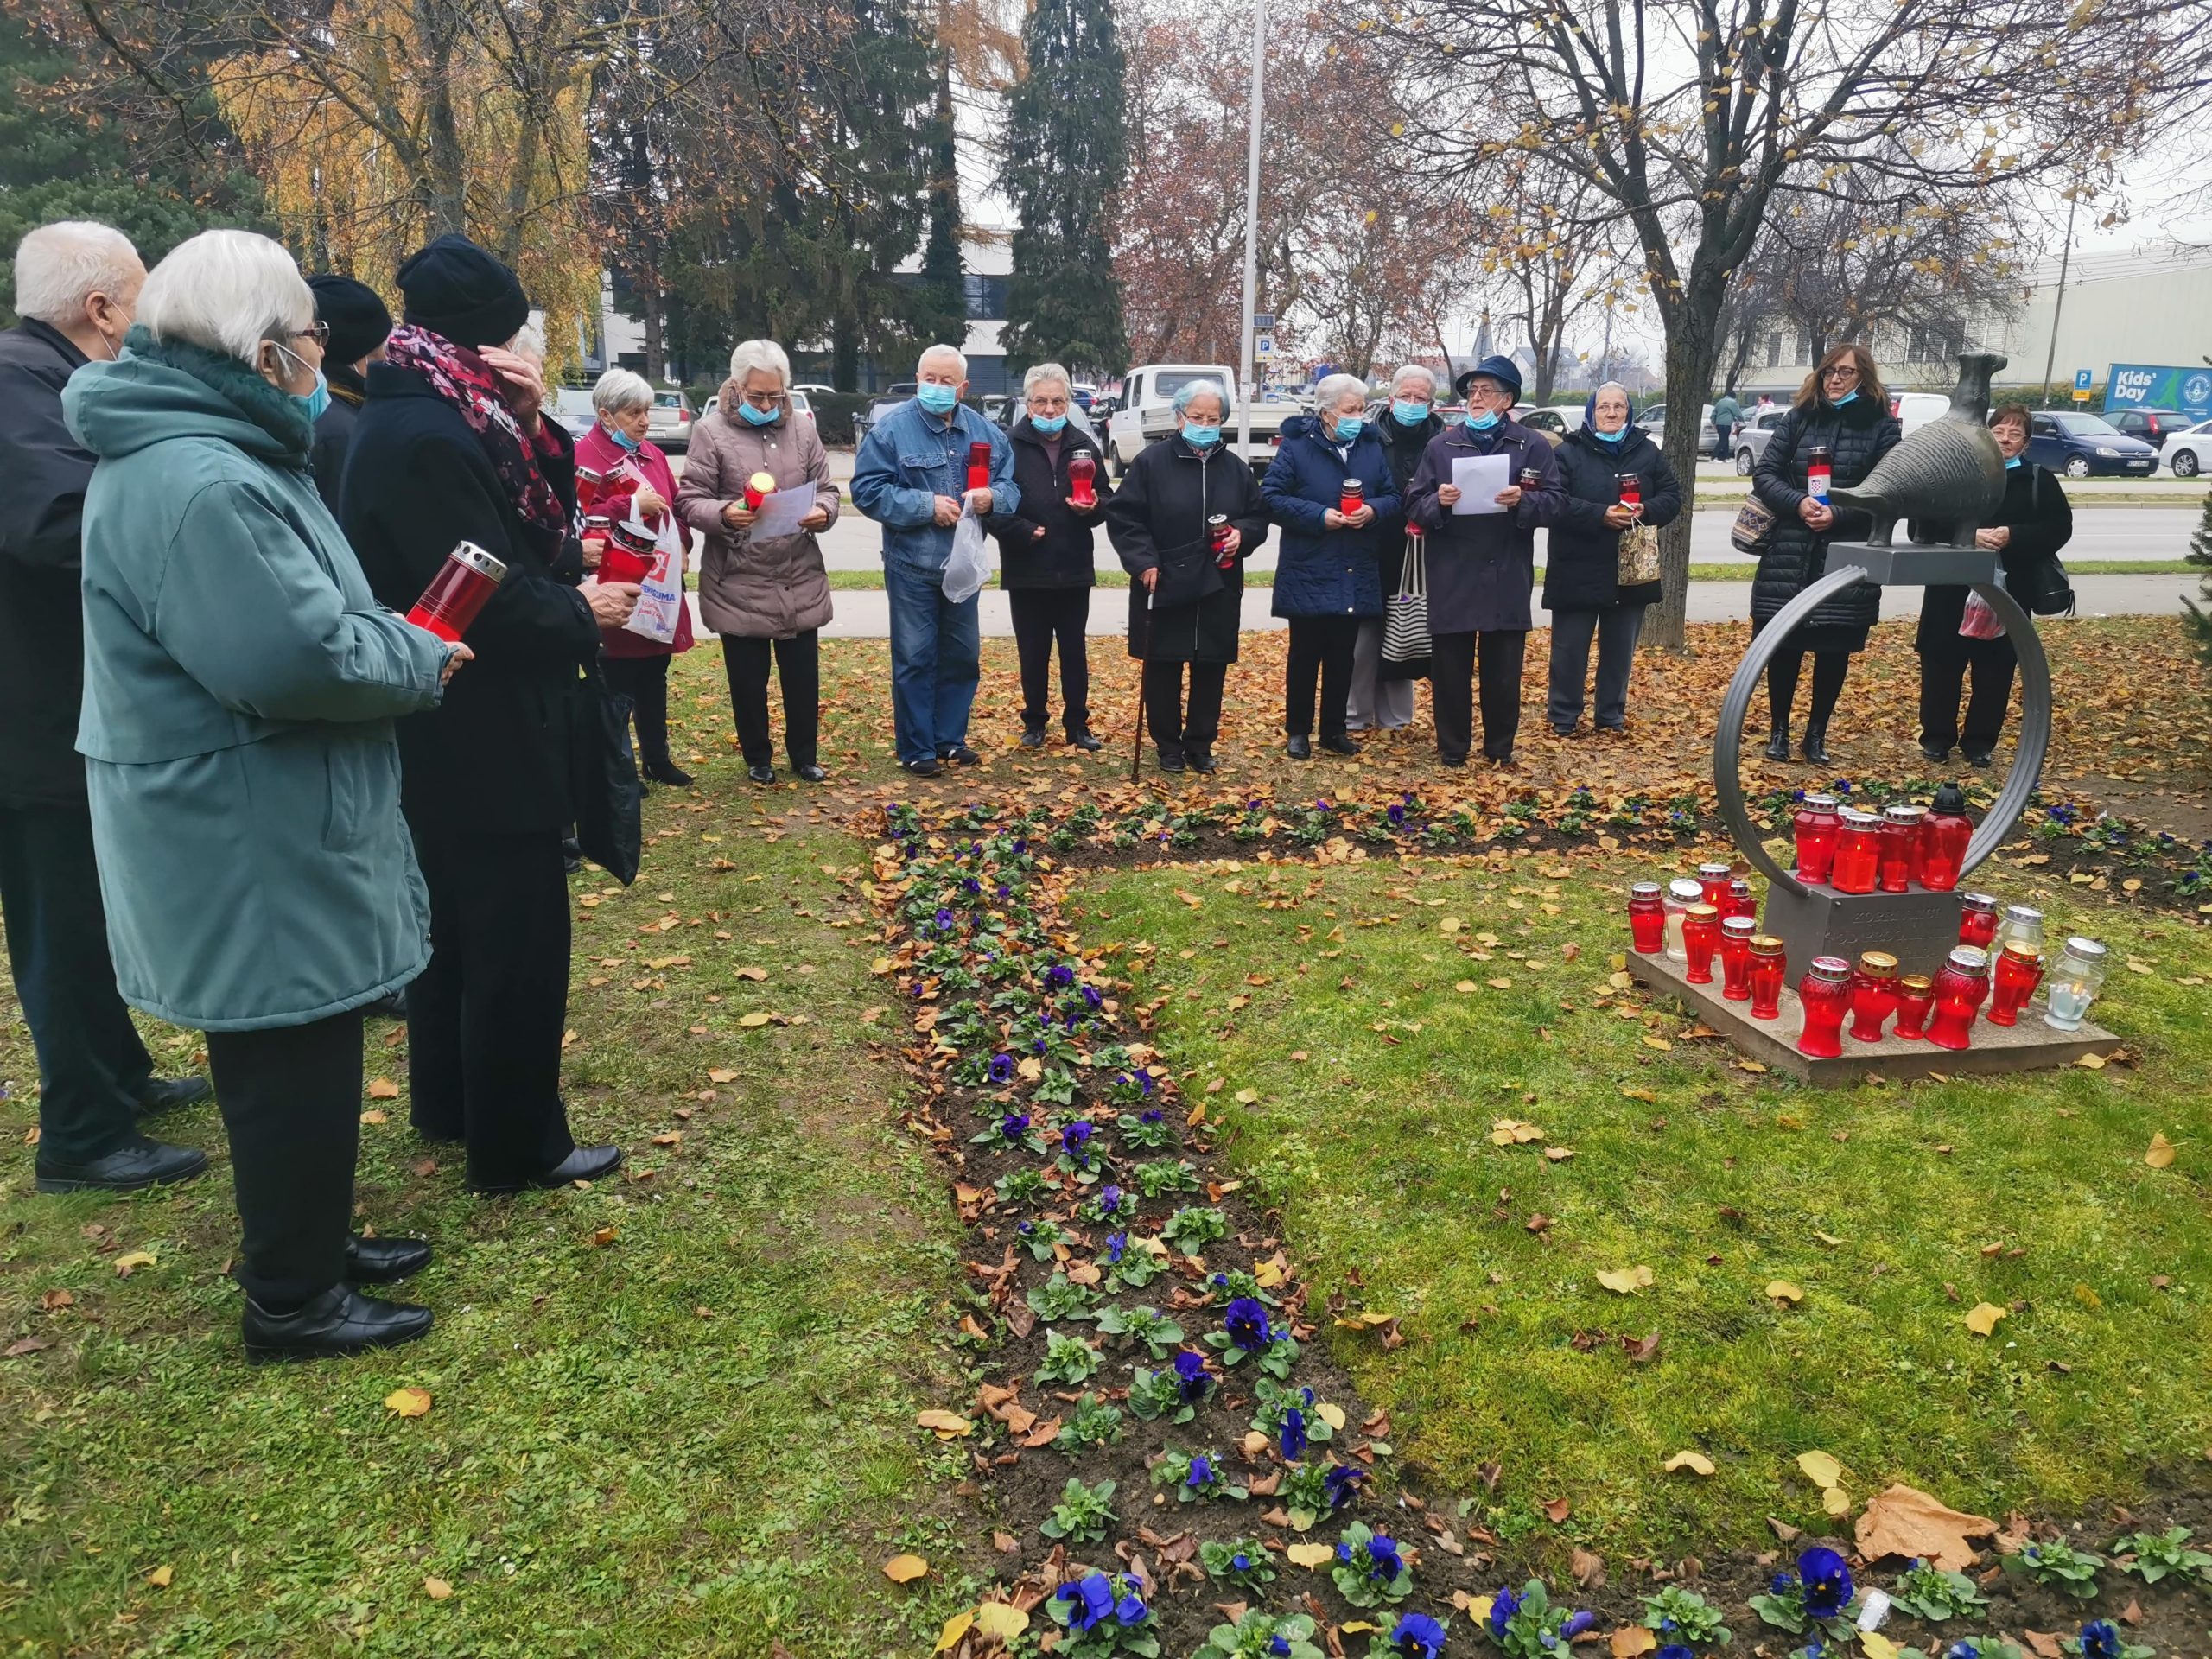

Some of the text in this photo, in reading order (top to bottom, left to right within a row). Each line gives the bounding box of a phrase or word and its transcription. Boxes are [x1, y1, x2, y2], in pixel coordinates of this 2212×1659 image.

[2079, 372, 2088, 386] P
[2117, 371, 2157, 385] Kids'
[2114, 385, 2147, 402] Day
